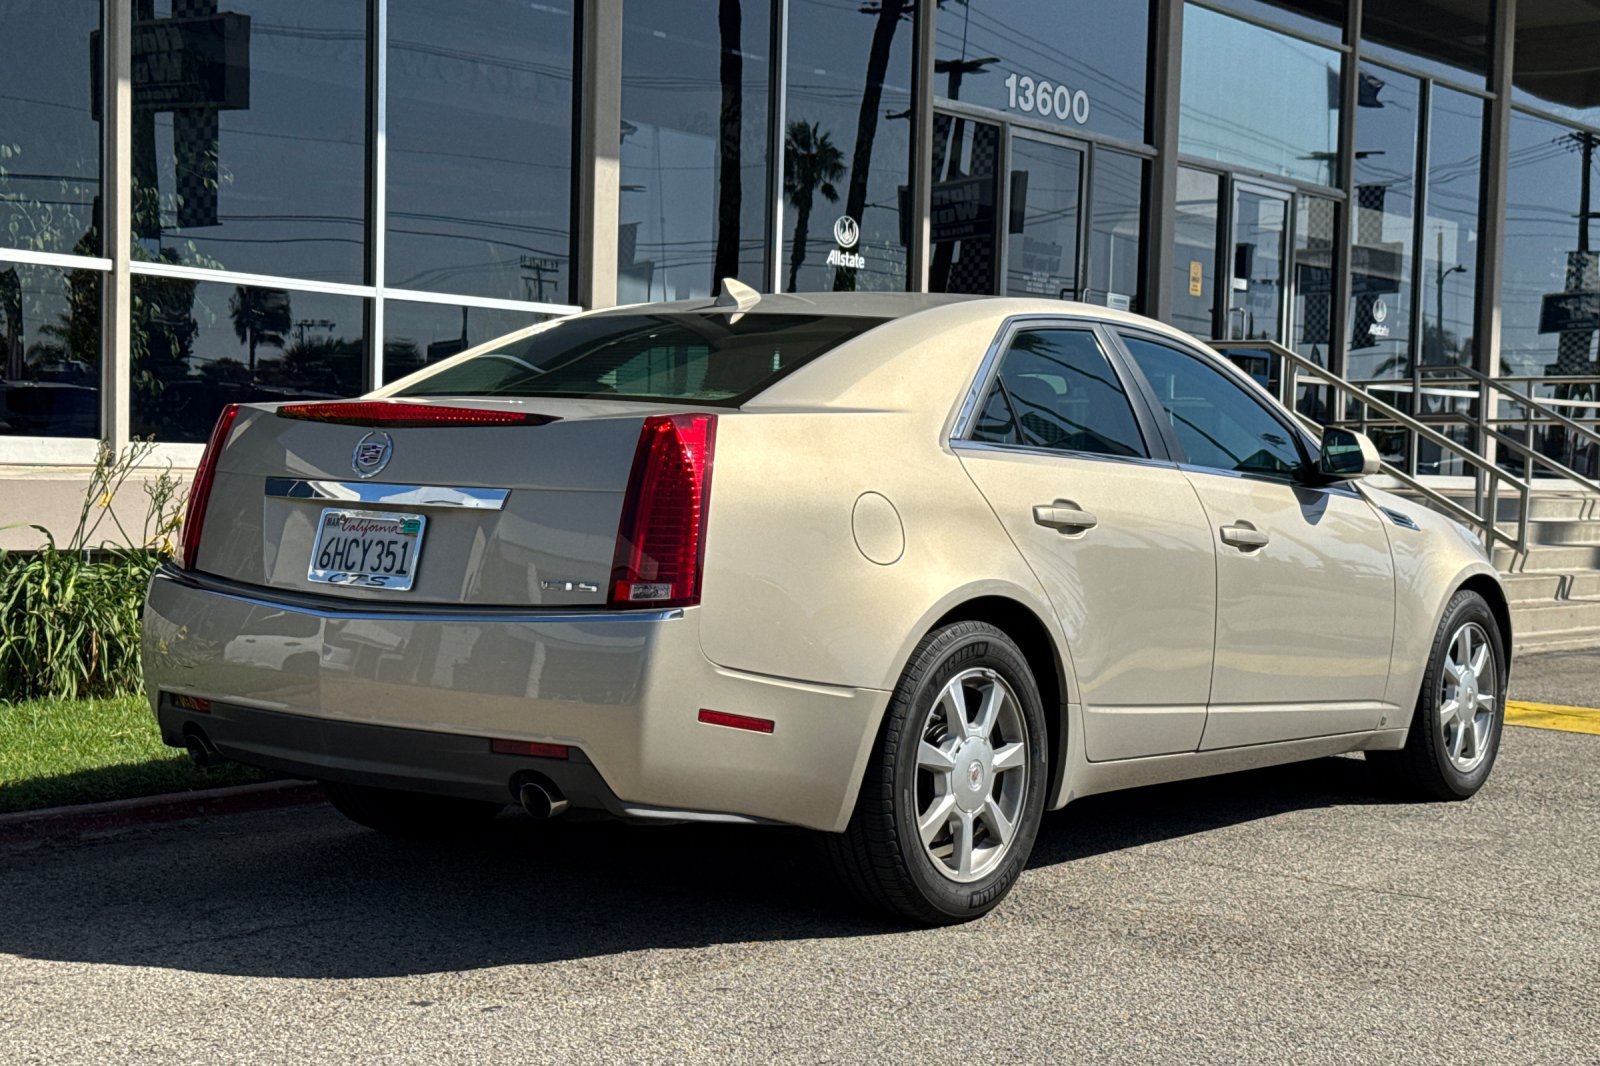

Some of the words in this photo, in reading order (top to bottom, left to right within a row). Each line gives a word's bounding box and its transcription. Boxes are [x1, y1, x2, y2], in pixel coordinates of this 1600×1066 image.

[1005, 73, 1090, 124] 13600
[826, 249, 866, 269] Allstate
[341, 517, 404, 537] California
[318, 537, 408, 575] 6HCY351
[327, 573, 390, 587] CTS
[934, 641, 989, 684] MICHELIN
